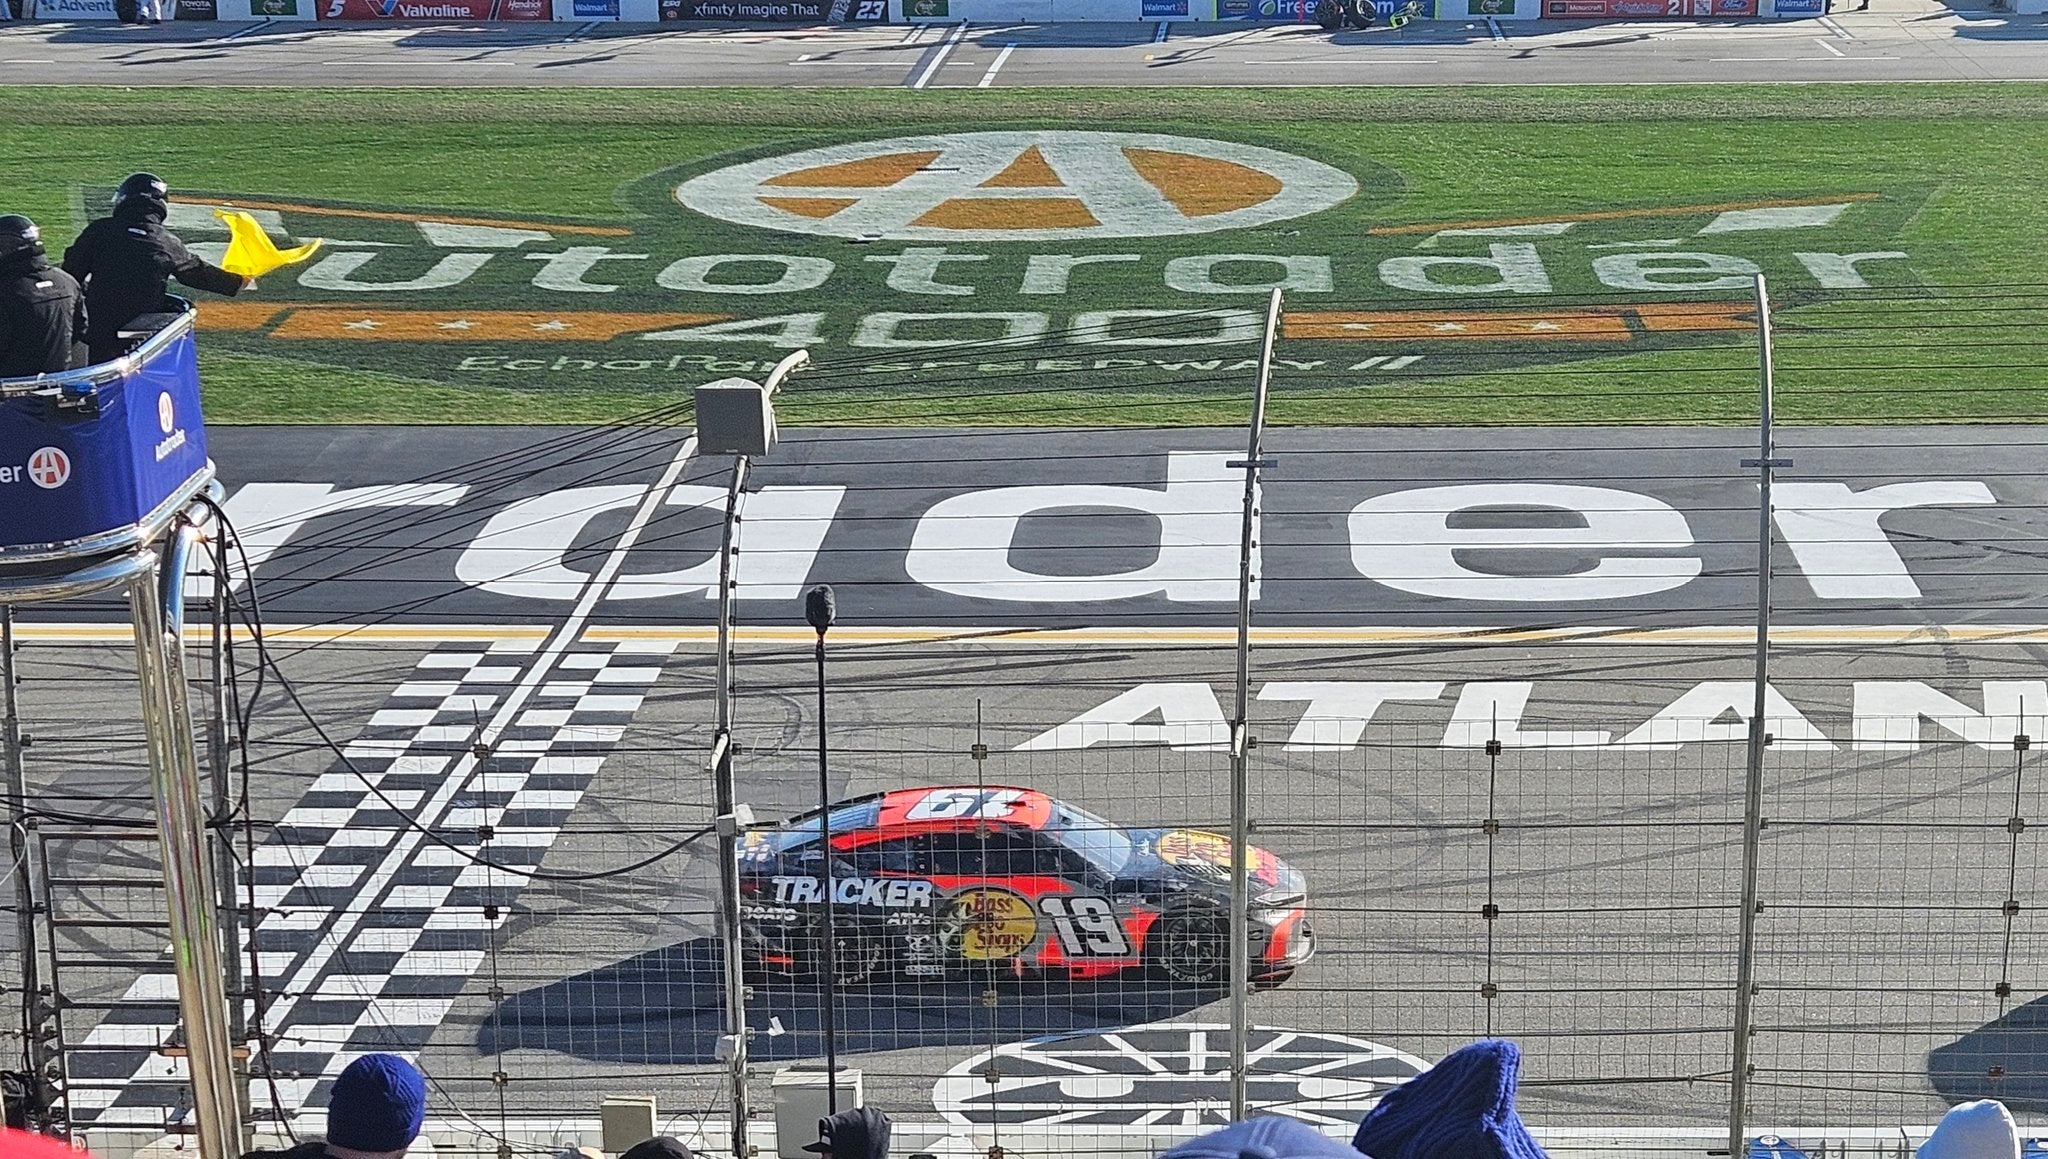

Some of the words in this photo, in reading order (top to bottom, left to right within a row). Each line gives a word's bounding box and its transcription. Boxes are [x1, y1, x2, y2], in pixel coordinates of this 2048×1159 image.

[326, 0, 346, 17] 5
[399, 4, 472, 17] Valvoline
[694, 4, 735, 16] xfinity
[738, 3, 787, 17] Imagine
[791, 3, 819, 15] That
[855, 1, 885, 19] 23
[1143, 3, 1176, 11] Walmart
[637, 311, 1267, 349] 400
[1013, 681, 2048, 752] ATLAN
[772, 875, 933, 908] TRACKER
[1040, 898, 1129, 954] 19
